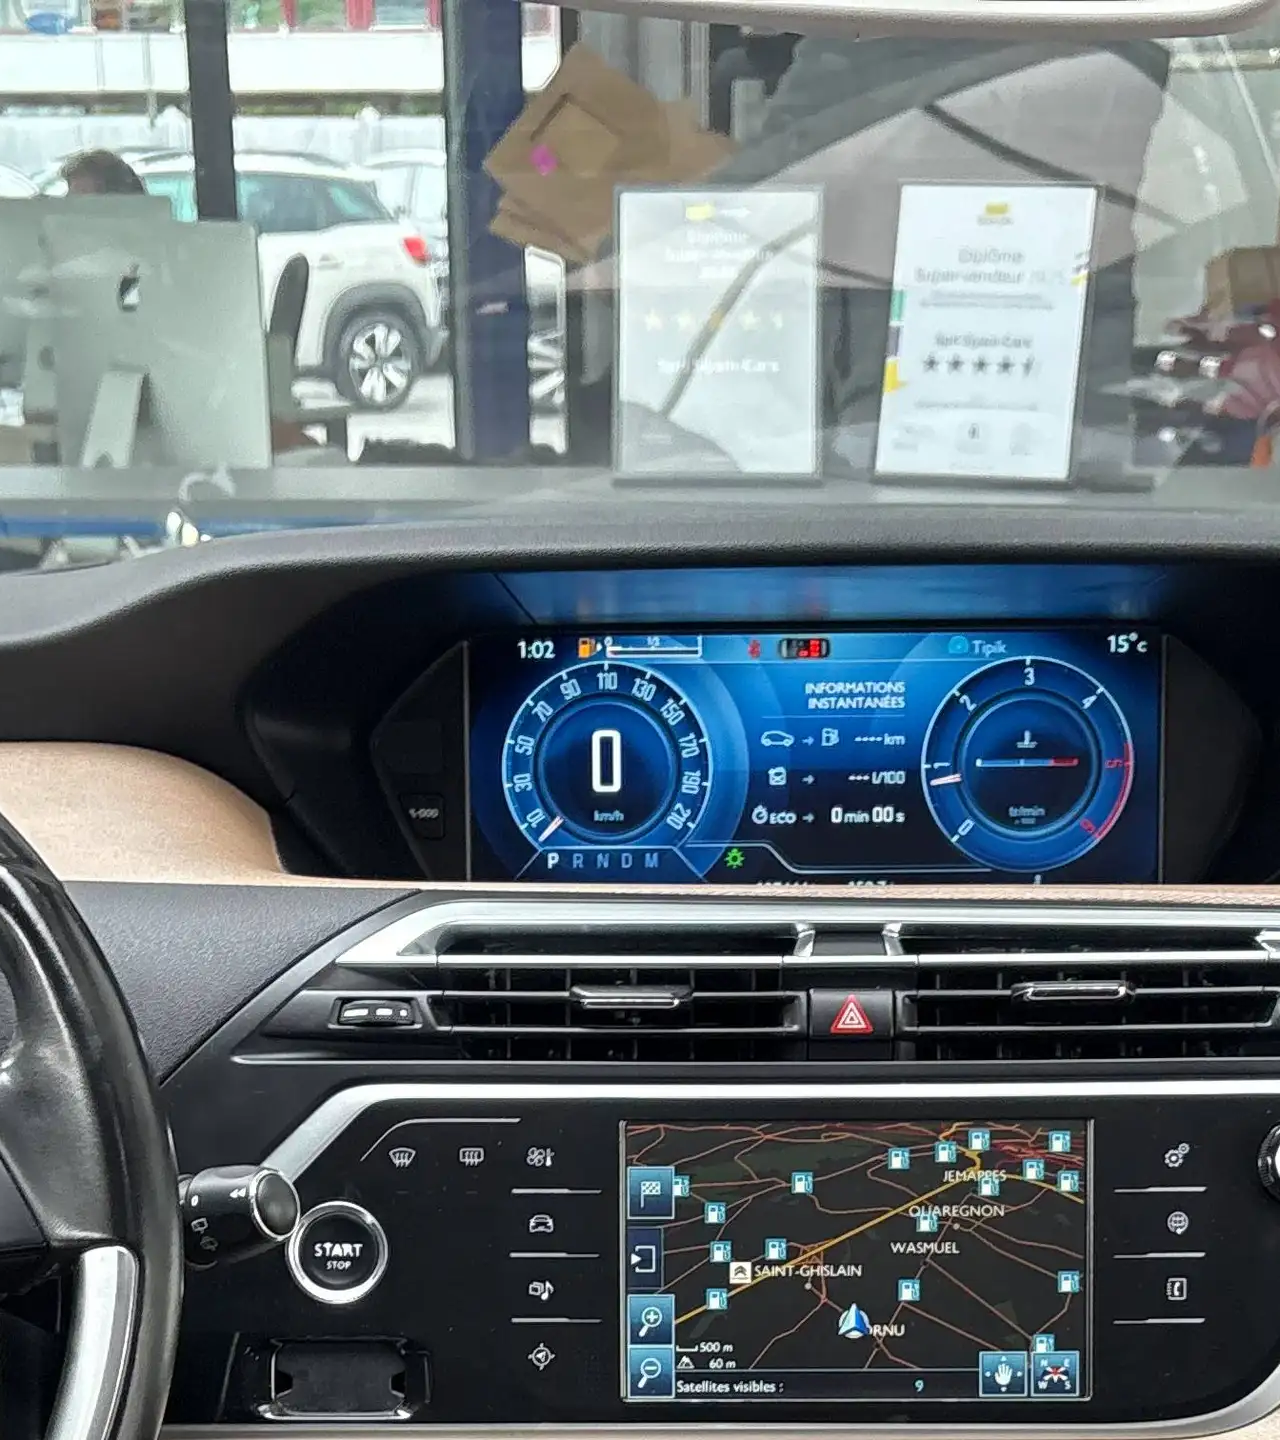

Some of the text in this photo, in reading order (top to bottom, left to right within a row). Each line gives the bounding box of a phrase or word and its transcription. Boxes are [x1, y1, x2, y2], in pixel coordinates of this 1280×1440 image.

[517, 640, 557, 659] 1:02
[971, 639, 1007, 658] Tipik
[596, 672, 618, 691] 110
[1024, 667, 1035, 686] 3
[559, 678, 582, 700] 90
[631, 677, 657, 702] 130
[804, 681, 906, 695] INFORMATIONS
[531, 700, 554, 722] 70
[658, 697, 686, 726] 150
[807, 694, 906, 710] INSTANTANÉES
[959, 694, 978, 714] 2
[1081, 694, 1098, 710] 4
[514, 734, 535, 756] 50
[677, 732, 701, 758] 170
[591, 729, 621, 793] 0
[512, 772, 533, 793] 30
[681, 769, 702, 796] 190
[525, 808, 547, 829] 10
[593, 809, 625, 822] km/h
[666, 802, 692, 831] 210
[769, 804, 906, 824] ECO 0 min 00 s
[546, 852, 659, 870] P R N D M
[943, 1169, 1007, 1182] JEMAPPES
[908, 1204, 1006, 1218] QUAREGNON
[314, 1241, 364, 1257] START
[890, 1242, 961, 1254] WASMUEL
[326, 1260, 352, 1270] STOP
[754, 1265, 862, 1278] SAINT-GHISLAIN
[699, 1342, 734, 1353] 500 m
[708, 1358, 737, 1370] 60 m
[676, 1380, 730, 1394] Satellites
[732, 1380, 777, 1394] visibles
[915, 1380, 925, 1393] 9
